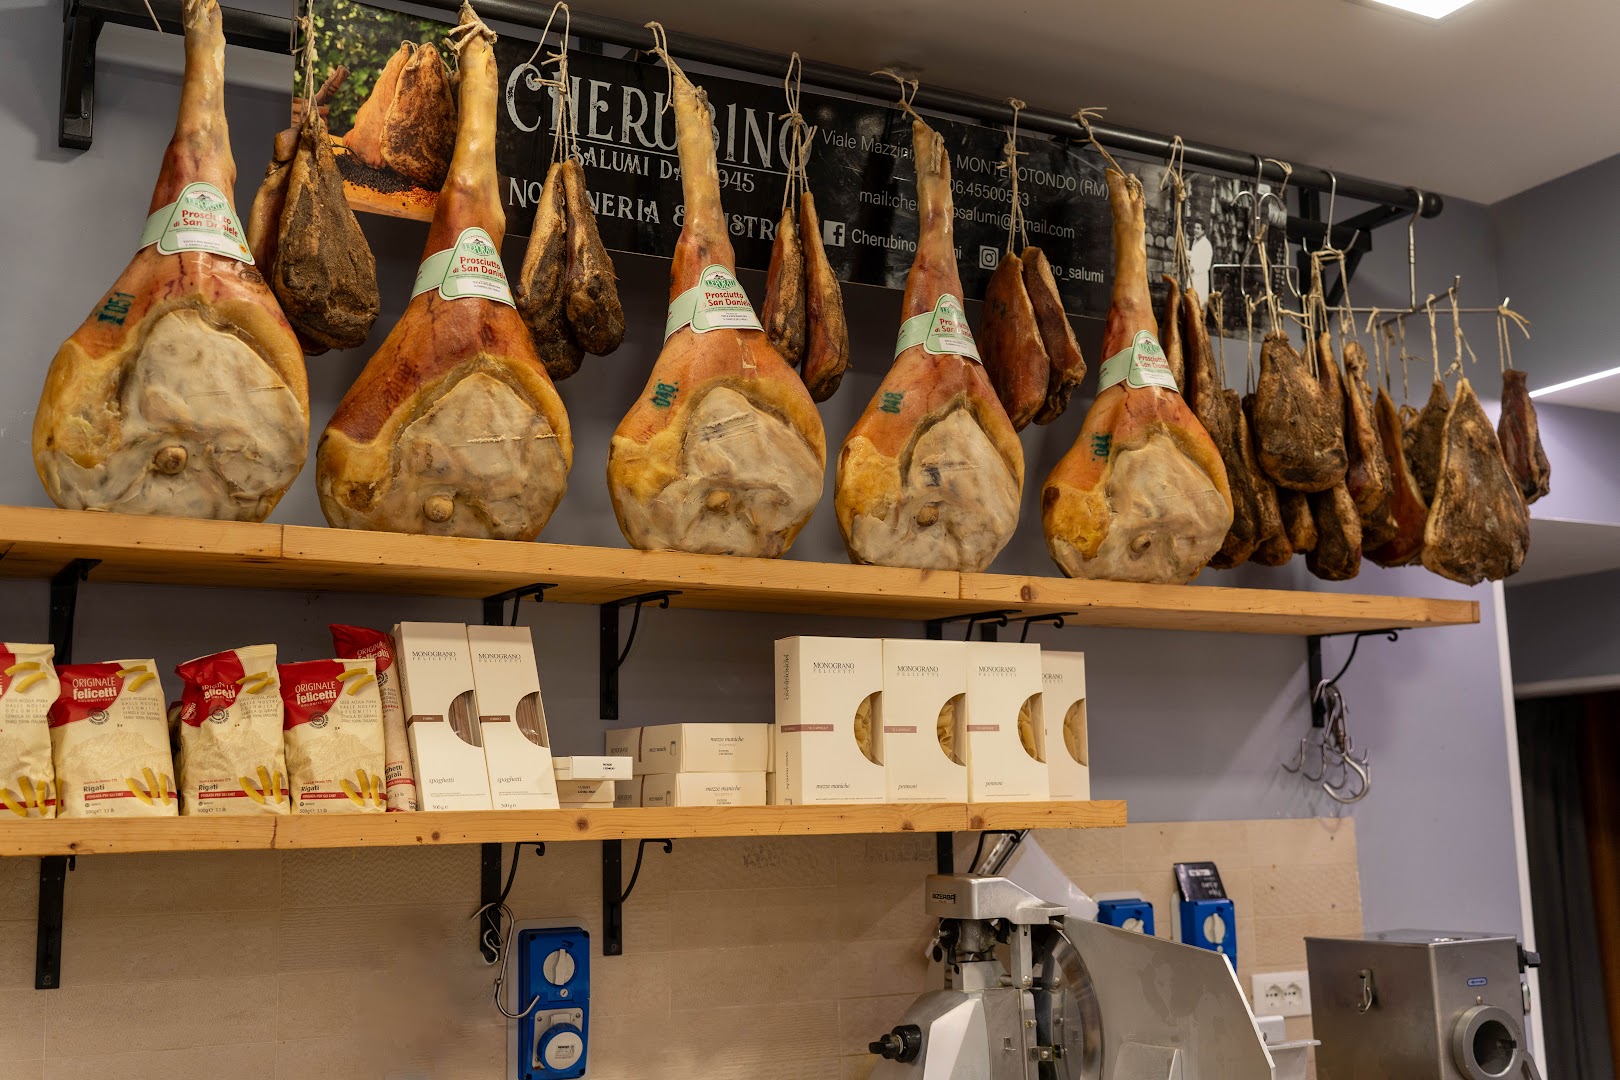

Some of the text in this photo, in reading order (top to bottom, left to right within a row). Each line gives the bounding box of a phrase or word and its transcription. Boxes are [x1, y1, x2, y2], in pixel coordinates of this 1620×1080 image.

[822, 128, 856, 149] Viale
[1080, 179, 1109, 200] (RM)
[182, 217, 203, 227] San
[851, 229, 917, 252] Cherubino
[459, 256, 501, 270] Prosciutto
[461, 265, 479, 273] San
[705, 290, 744, 300] Prosciutto
[707, 299, 724, 307] San
[72, 677, 116, 688] ORIGINALE
[202, 681, 235, 690] RIGINLE
[295, 681, 336, 693] ORIGINALE
[72, 687, 117, 701] felicetti
[296, 690, 337, 705] felicetti
[429, 776, 455, 784] spaghetti
[83, 784, 105, 792] Rigati
